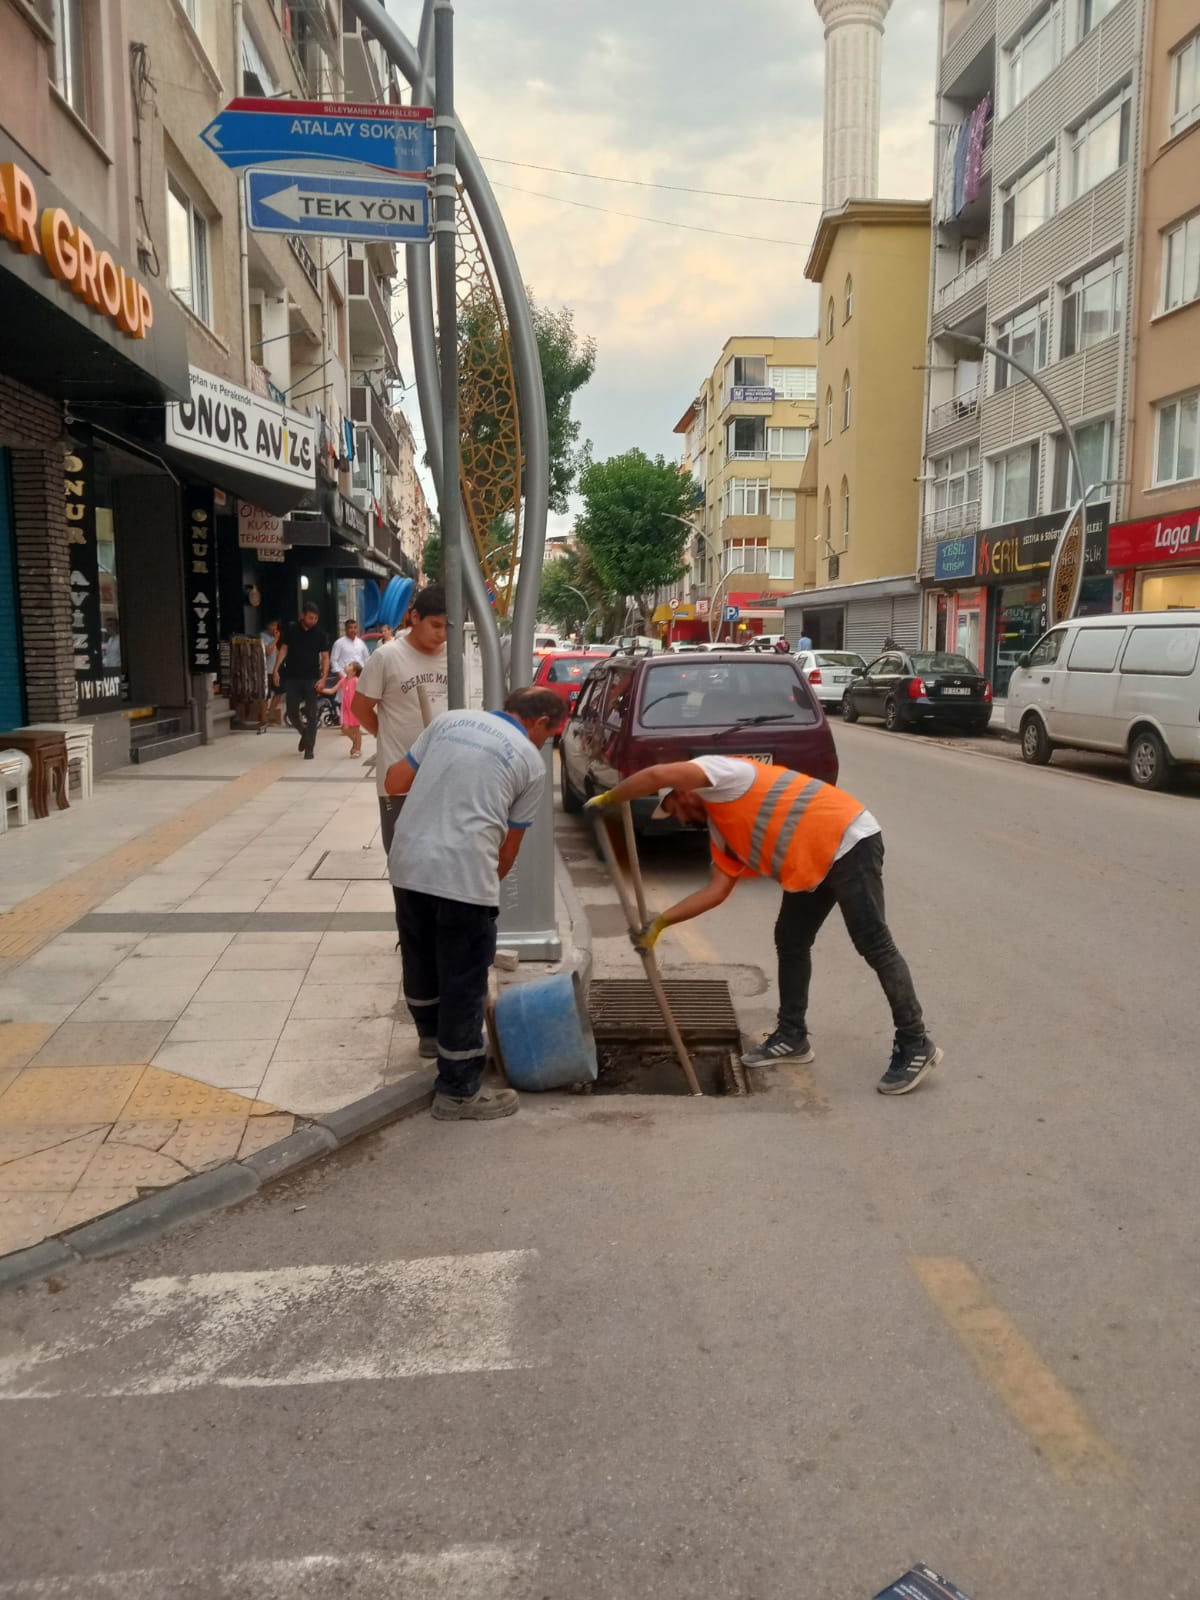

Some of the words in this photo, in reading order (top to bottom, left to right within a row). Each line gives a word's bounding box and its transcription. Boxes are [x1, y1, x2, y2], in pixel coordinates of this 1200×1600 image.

[323, 105, 378, 116] SÜLEYMANBEY
[290, 119, 354, 137] ATALAY
[359, 123, 420, 140] SOKAK
[298, 196, 352, 218] TEK
[360, 199, 416, 222] YÖN
[41, 207, 153, 339] GROUP
[209, 382, 218, 393] ve
[179, 393, 249, 451] ONUR
[191, 508, 209, 574] ONUR
[1155, 522, 1191, 554] Laga
[726, 607, 736, 620] P
[192, 591, 210, 665] AVİZE
[400, 673, 434, 695] OCEANIC
